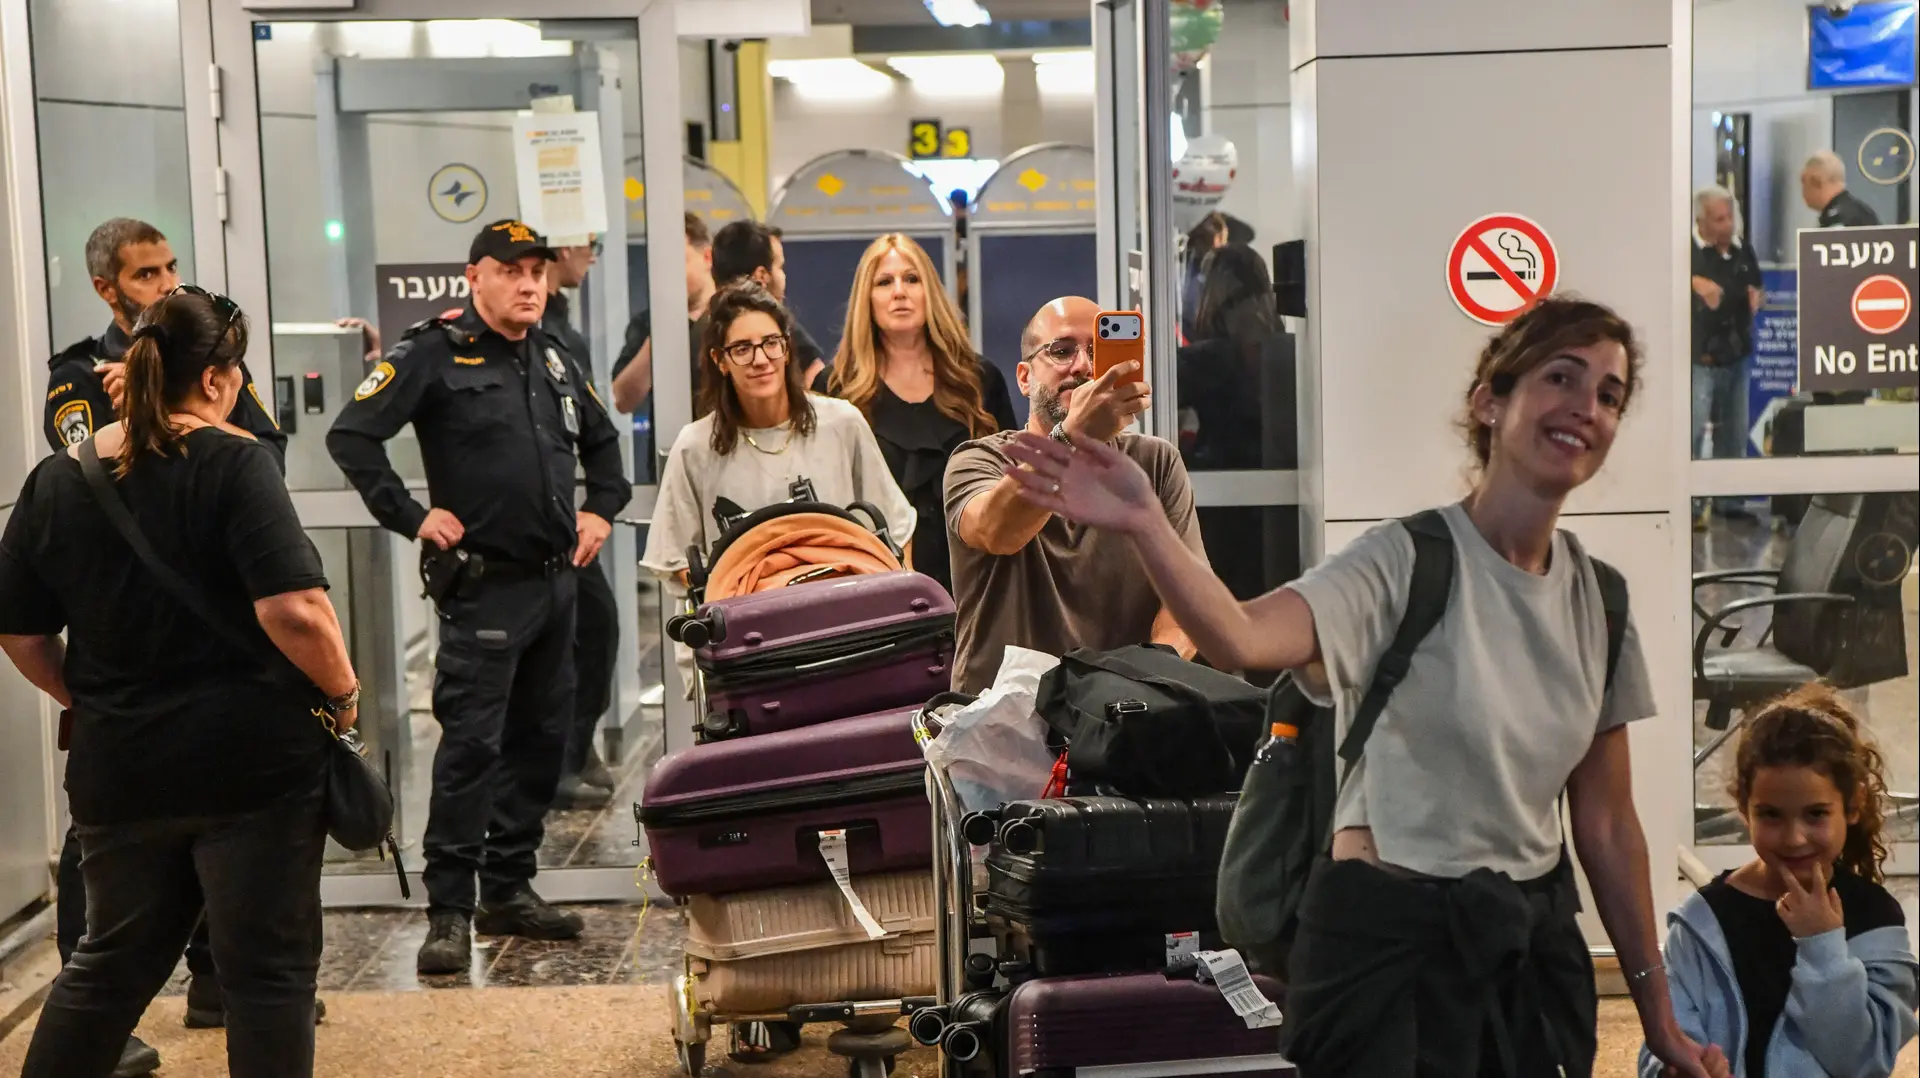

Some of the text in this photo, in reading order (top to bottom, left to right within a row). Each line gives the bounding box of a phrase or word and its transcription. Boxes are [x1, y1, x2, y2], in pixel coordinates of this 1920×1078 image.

[913, 123, 938, 155] 3
[946, 130, 969, 158] 3
[1812, 240, 1895, 269] מעבר
[389, 275, 470, 300] מעבר
[1815, 345, 1857, 375] No
[1867, 343, 1919, 373] Ent
